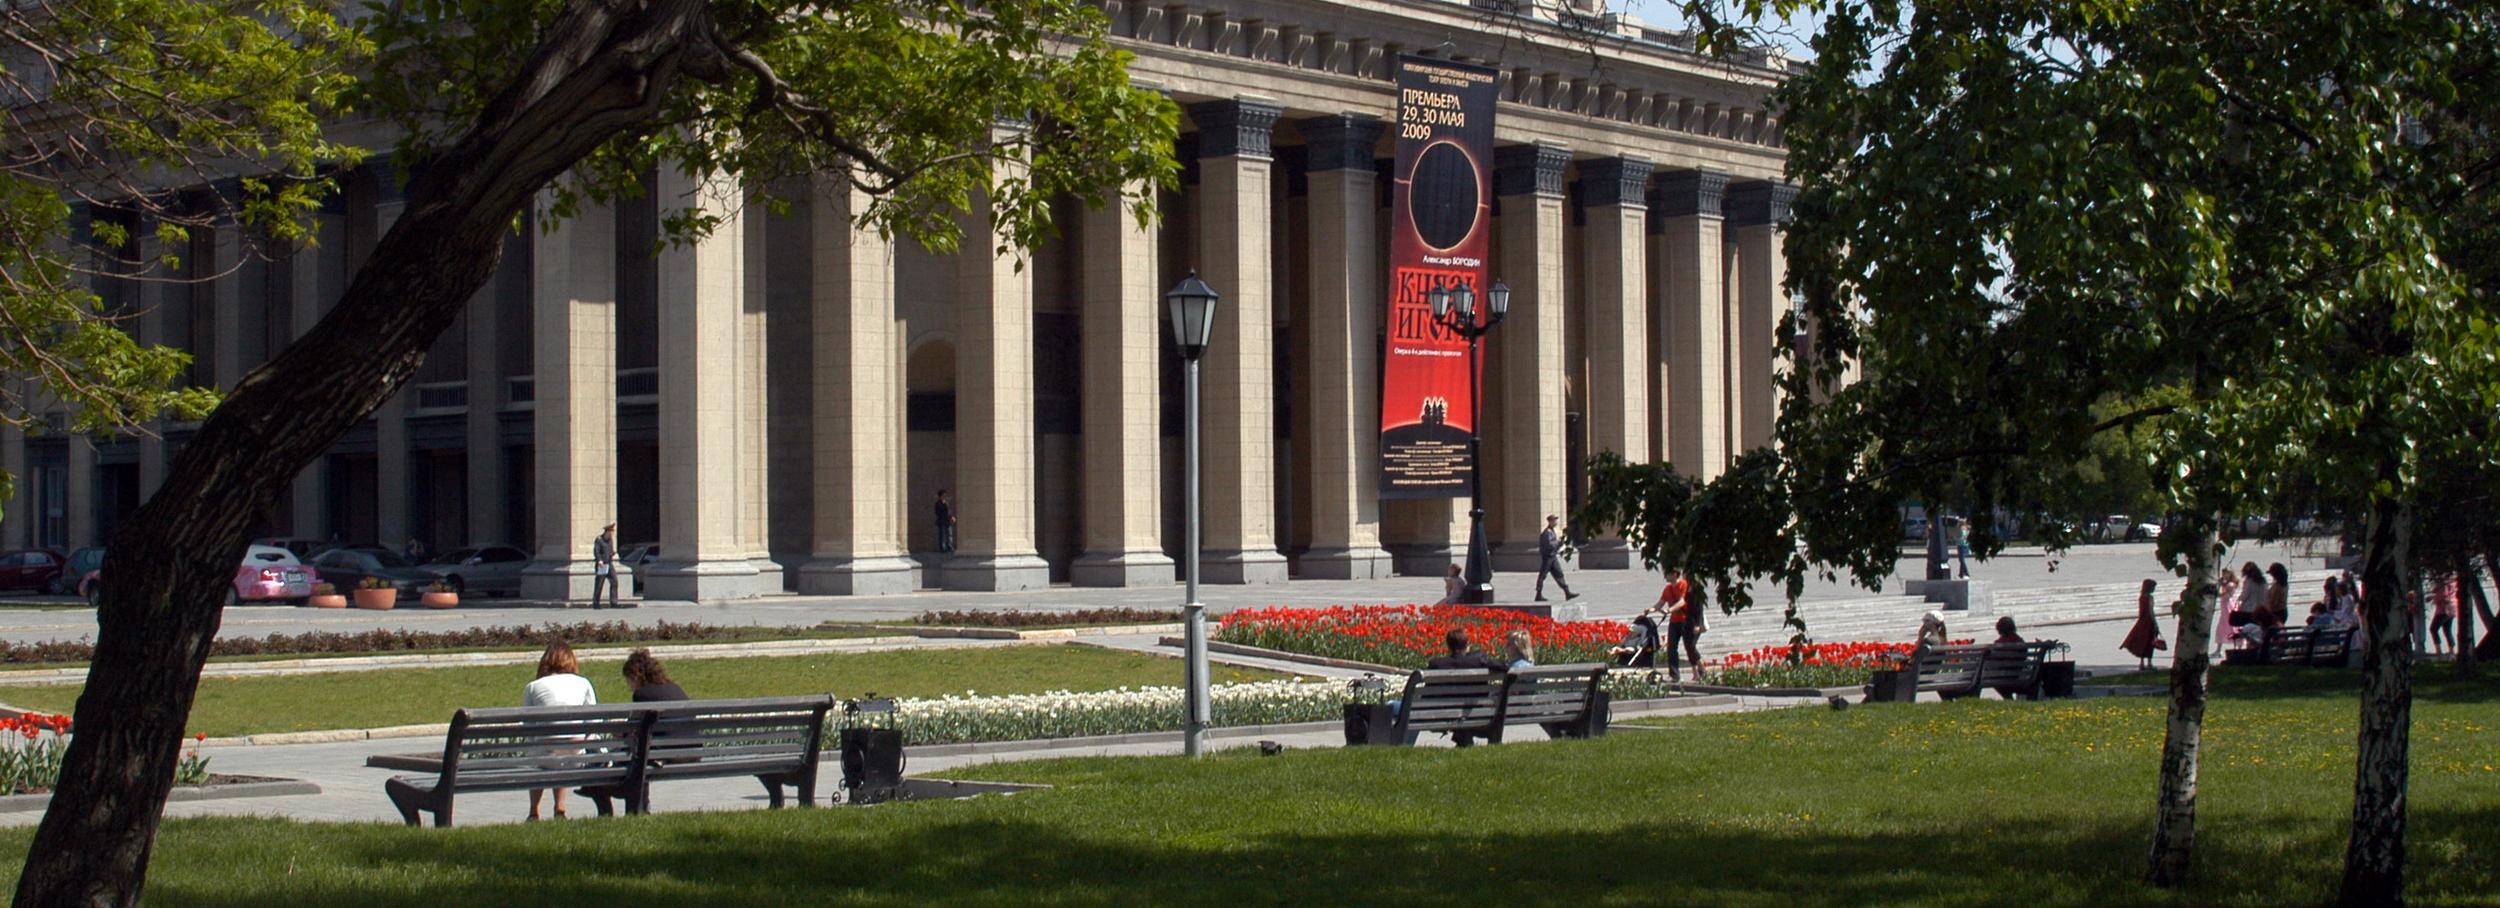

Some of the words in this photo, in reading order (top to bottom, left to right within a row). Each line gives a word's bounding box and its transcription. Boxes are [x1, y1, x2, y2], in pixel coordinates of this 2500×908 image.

[1403, 89, 1460, 110] ПРЕМЬЕРА
[1423, 109, 1437, 124] 30
[1439, 111, 1464, 127] МАЯ
[1402, 123, 1431, 140] 2009
